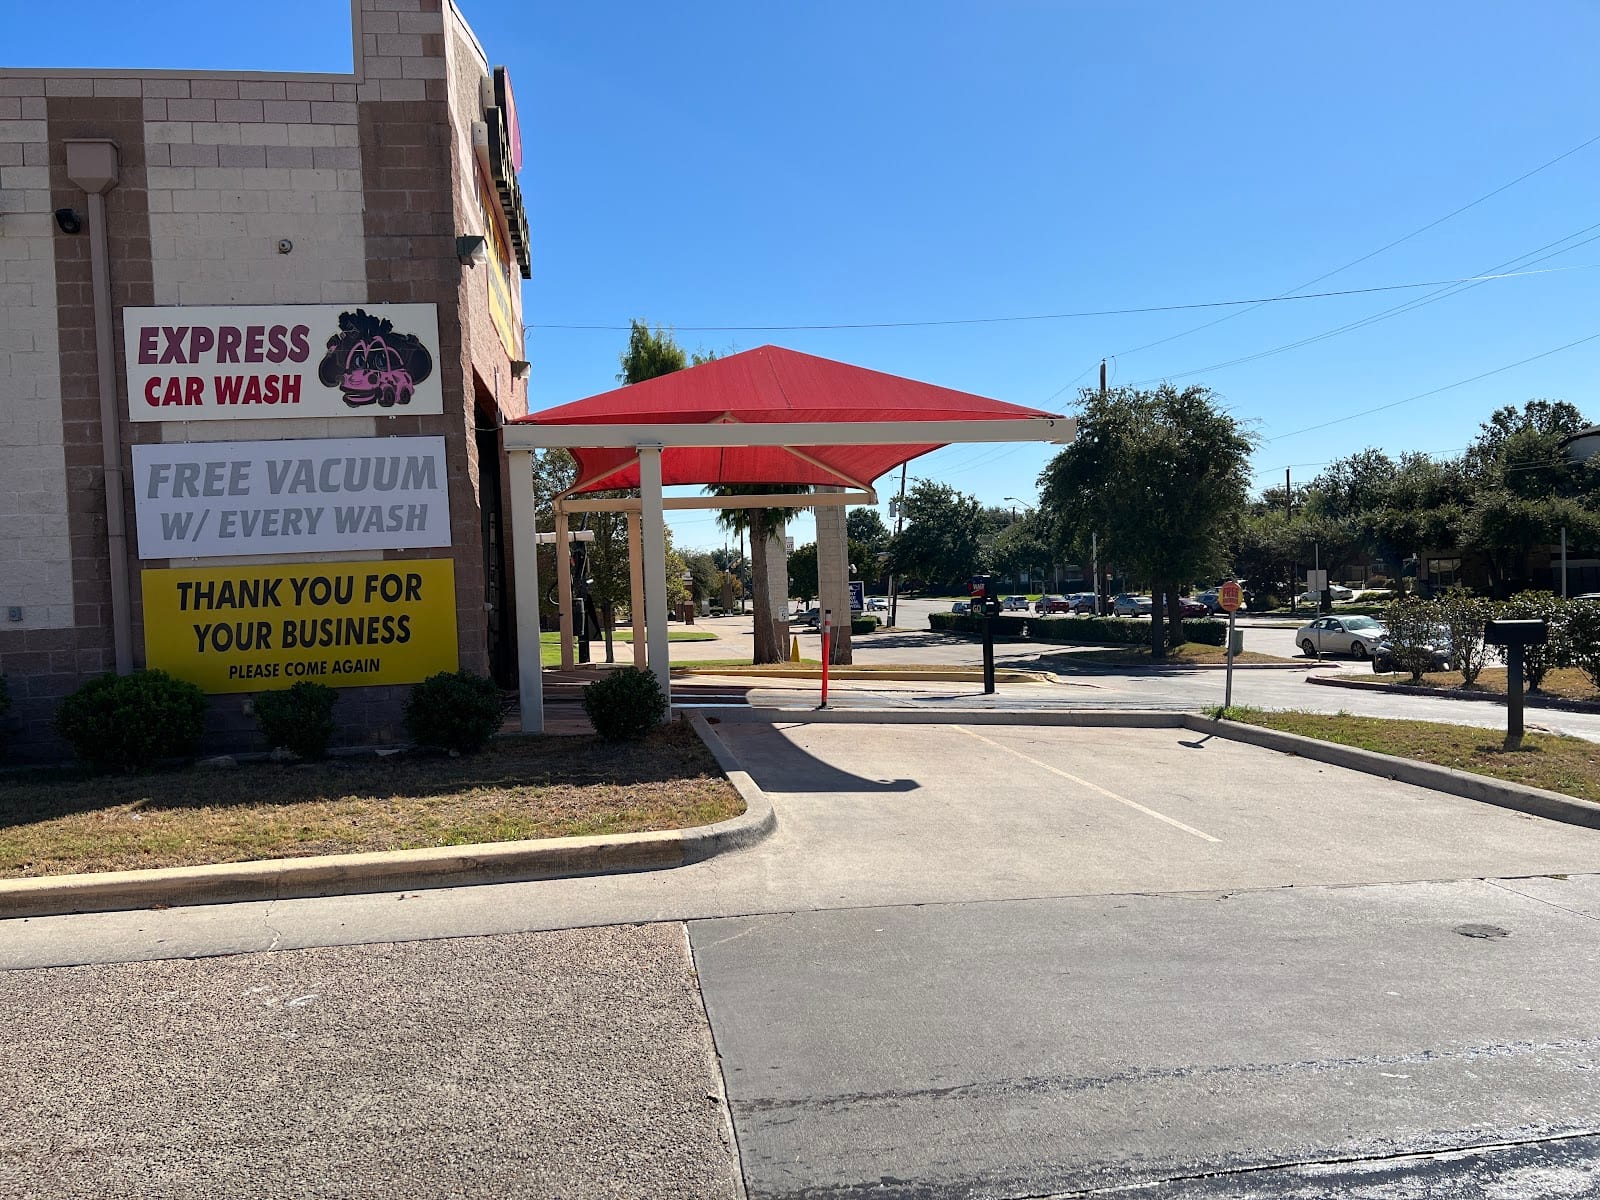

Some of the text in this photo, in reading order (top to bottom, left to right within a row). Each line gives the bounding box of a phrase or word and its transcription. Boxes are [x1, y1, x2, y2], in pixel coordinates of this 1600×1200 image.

[138, 325, 310, 365] EXPRESS
[144, 374, 302, 406] CAR WASH
[147, 455, 438, 499] FREE VACUUM
[161, 504, 428, 542] W/ EVERY WASH
[176, 573, 422, 611] THANK YOU FOR
[973, 604, 982, 612] GO
[193, 615, 411, 653] YOUR BUSINESS
[228, 658, 380, 680] PLEASE COME AGAIN
